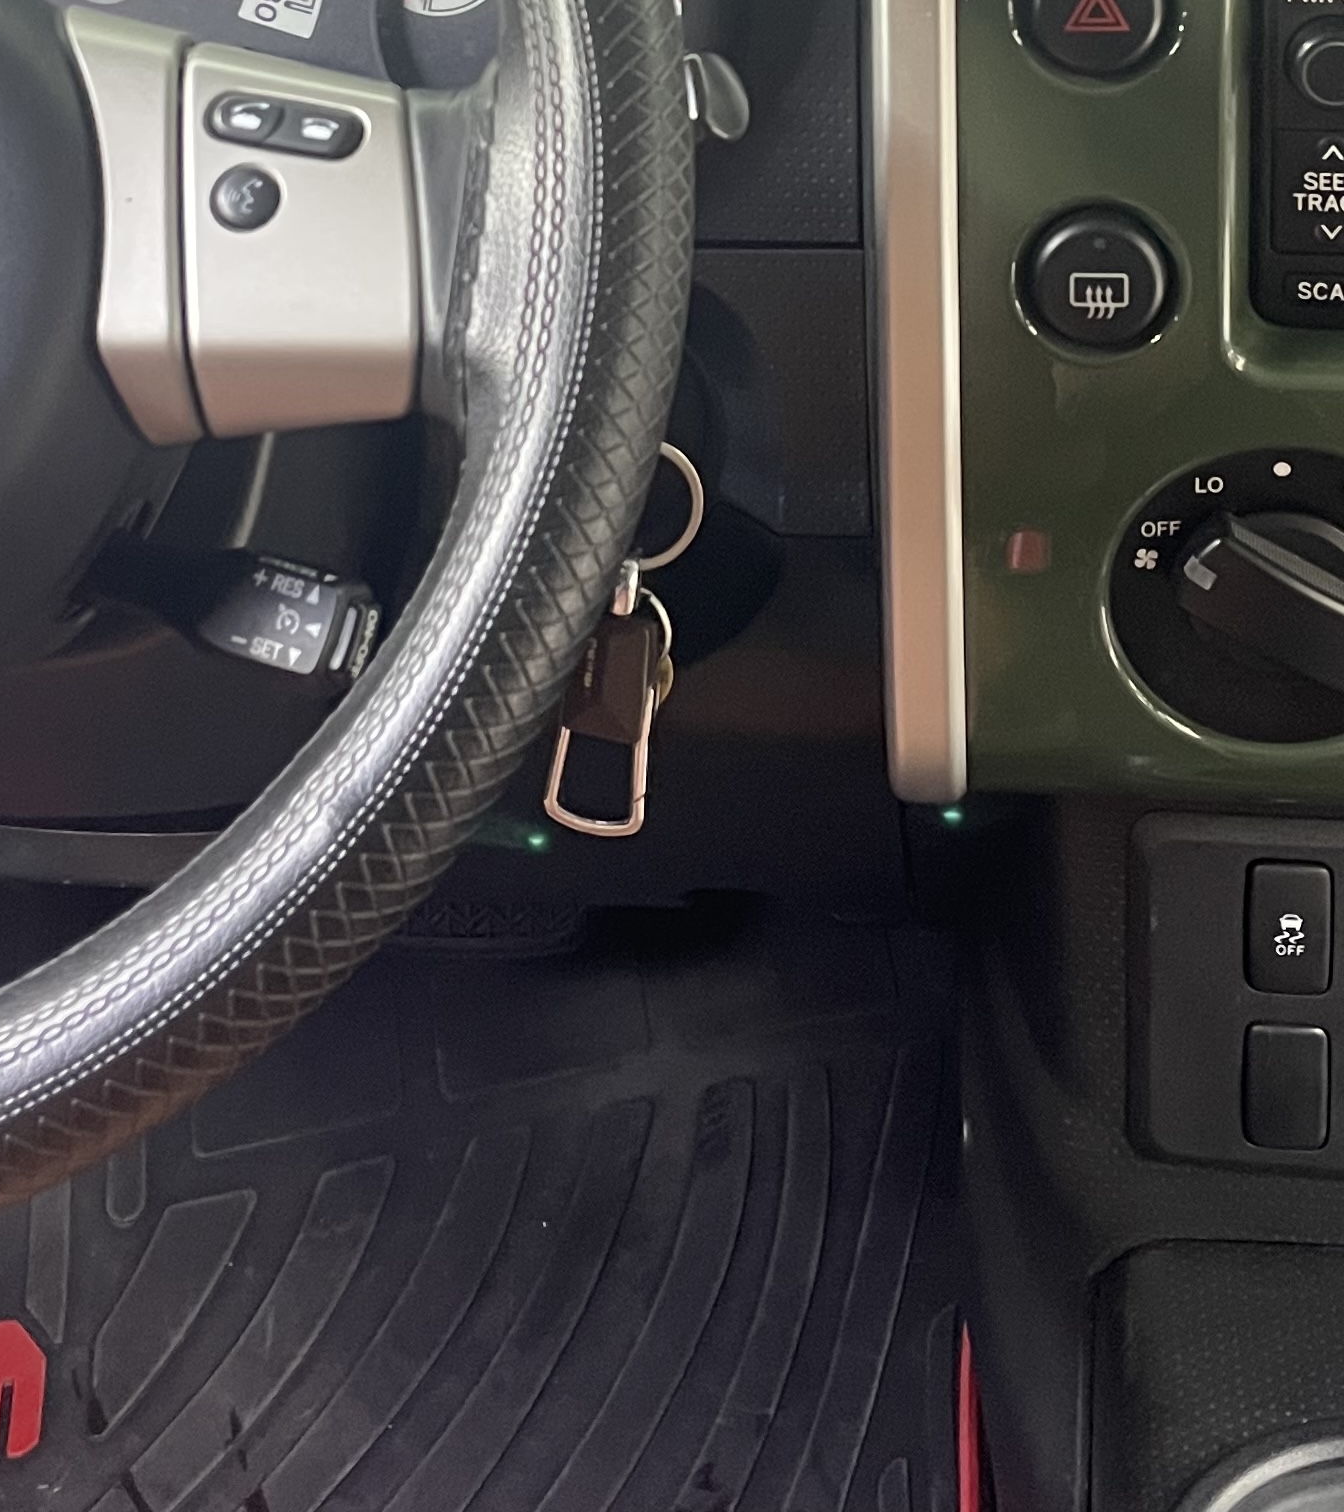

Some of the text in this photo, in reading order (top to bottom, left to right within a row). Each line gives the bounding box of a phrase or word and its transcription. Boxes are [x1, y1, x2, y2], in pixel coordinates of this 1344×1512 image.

[1194, 477, 1224, 494] LO
[1140, 520, 1181, 539] OFF
[270, 573, 305, 599] RES
[249, 637, 285, 660] SET
[1275, 944, 1305, 957] OFF
